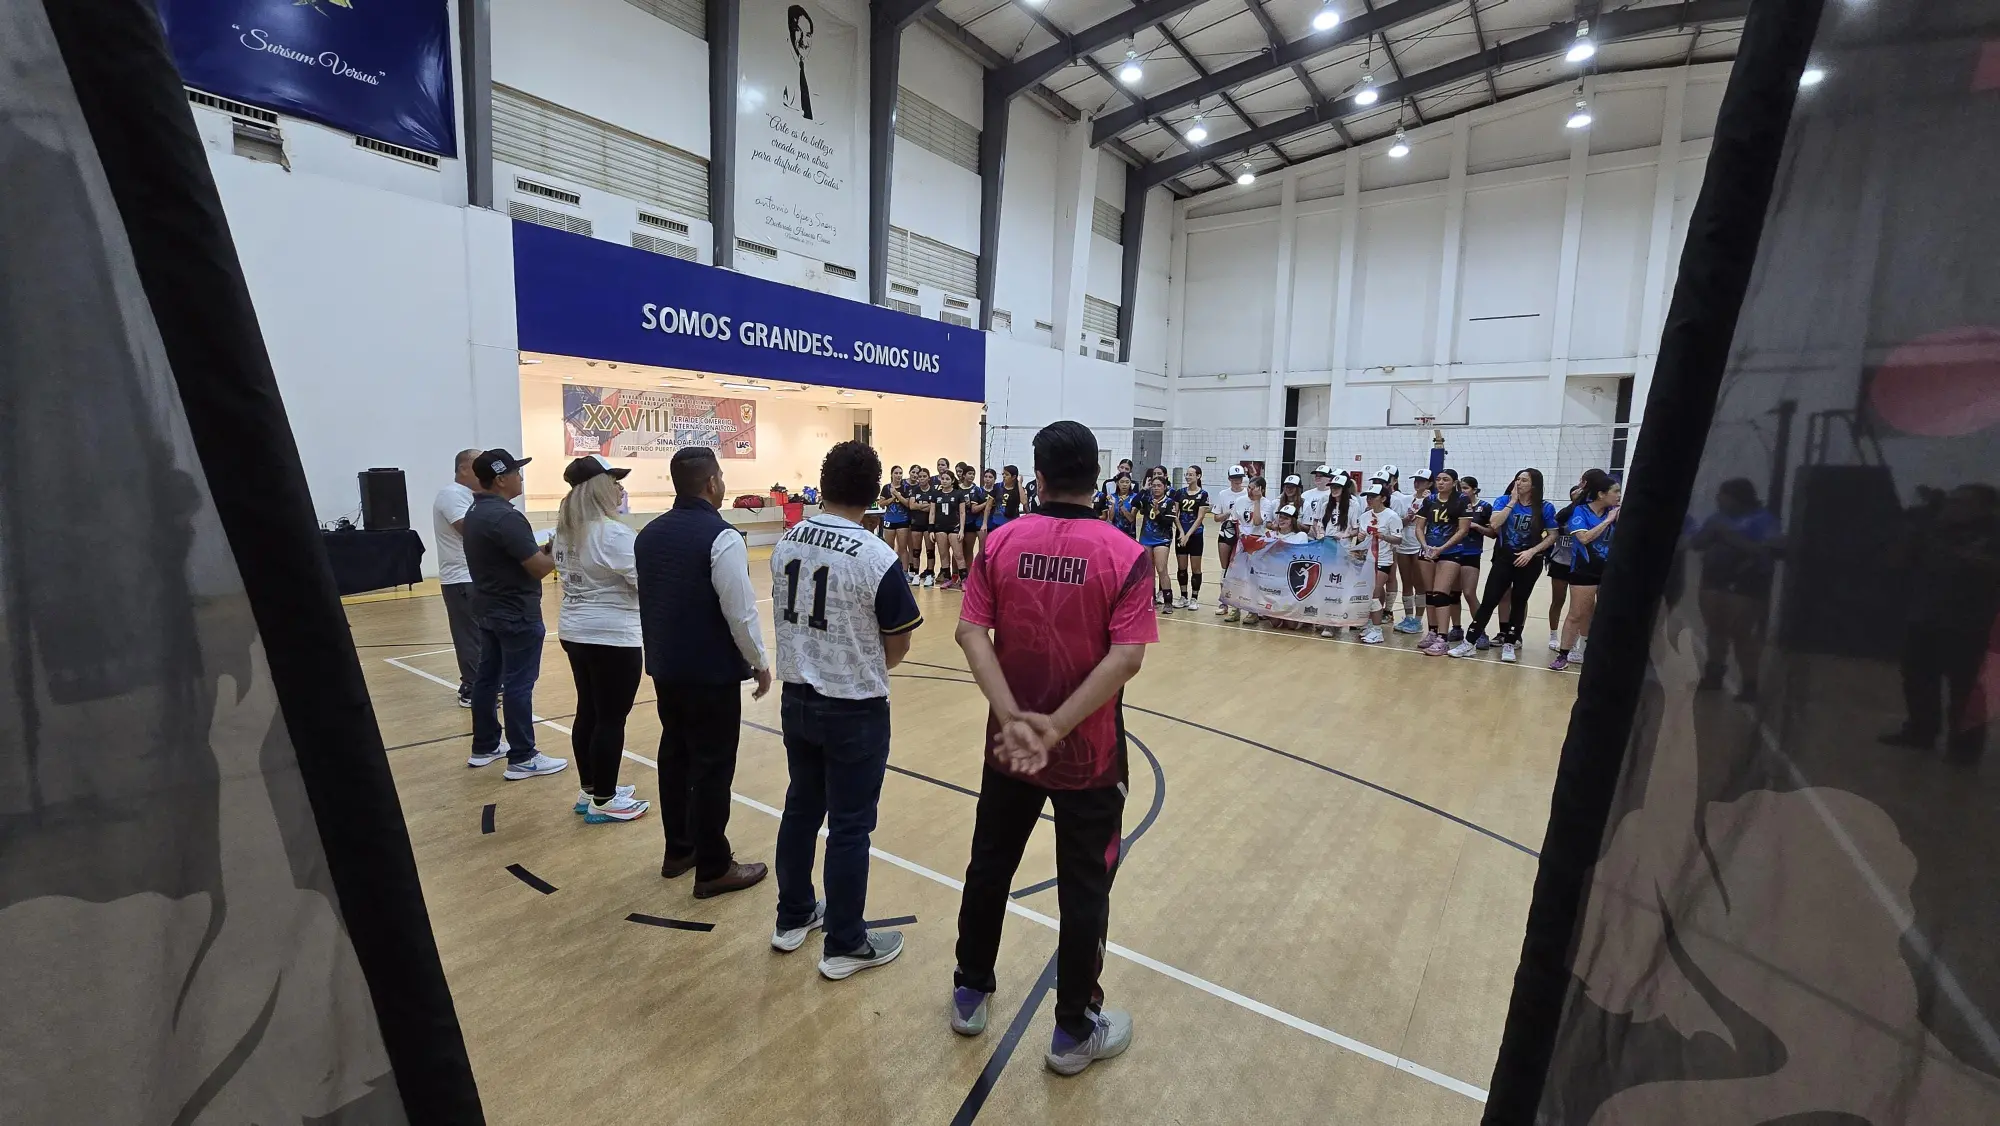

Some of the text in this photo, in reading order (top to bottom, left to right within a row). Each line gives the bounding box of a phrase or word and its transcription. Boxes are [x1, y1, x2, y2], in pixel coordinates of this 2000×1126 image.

[771, 139, 829, 169] creada por otros
[790, 130, 798, 139] es
[800, 131, 808, 143] la
[810, 135, 834, 157] belleza
[751, 149, 771, 163] para
[773, 155, 801, 174] disfrute
[802, 167, 812, 179] de
[641, 302, 941, 374] SOMOS GRANDES... SOMOS UAS
[583, 403, 669, 433] XXVIII
[656, 438, 686, 446] SINALOA
[1181, 498, 1195, 512] 22
[1432, 508, 1449, 523] 14
[1512, 513, 1533, 532] 15
[1017, 552, 1089, 586] COACH
[783, 558, 831, 632] 11
